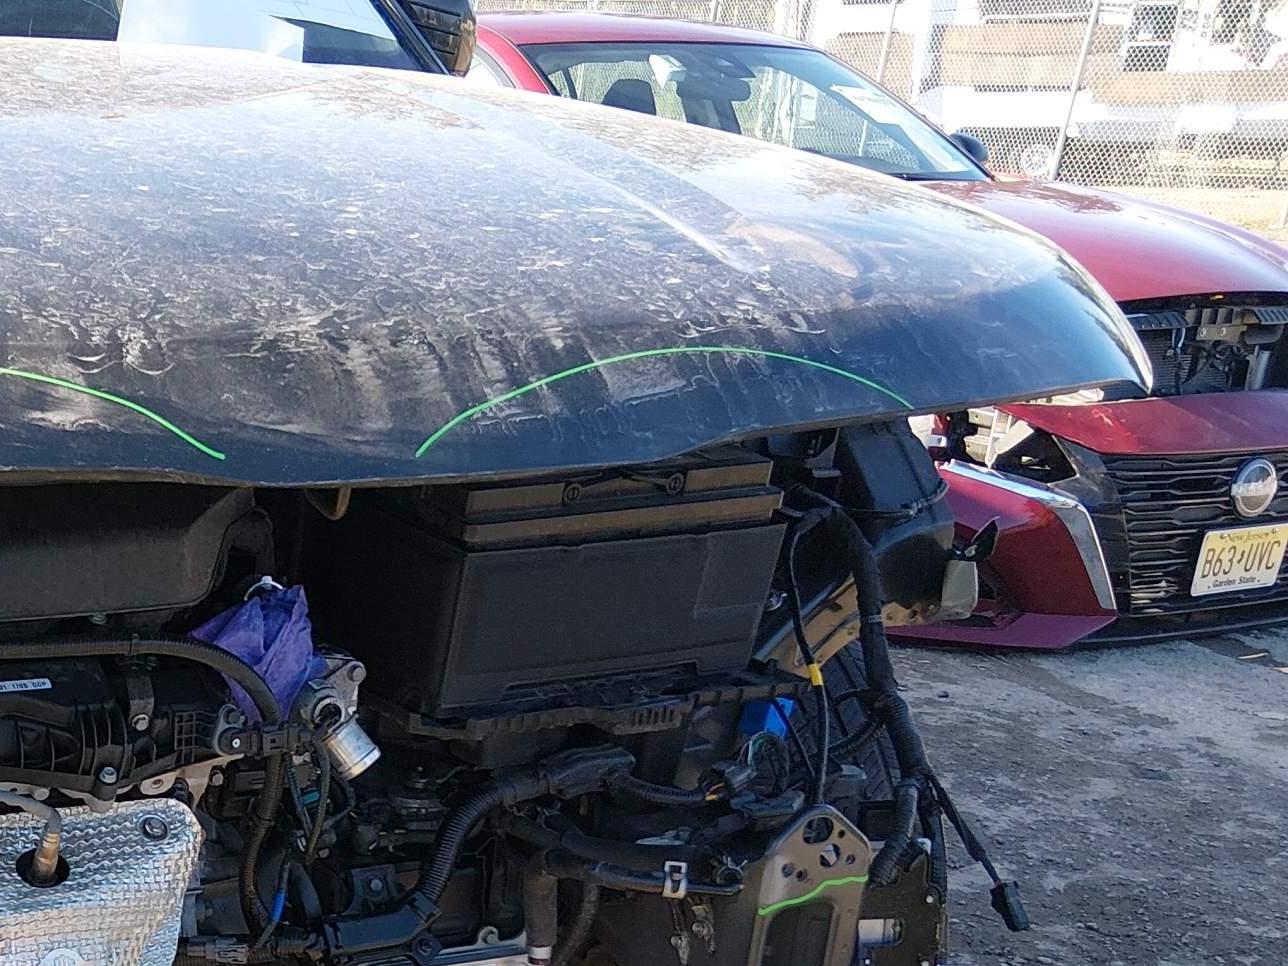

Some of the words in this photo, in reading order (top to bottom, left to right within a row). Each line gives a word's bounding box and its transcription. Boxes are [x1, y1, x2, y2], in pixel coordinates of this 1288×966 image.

[1200, 545, 1237, 578] B63
[1244, 540, 1281, 573] UVC
[1238, 576, 1257, 585] State
